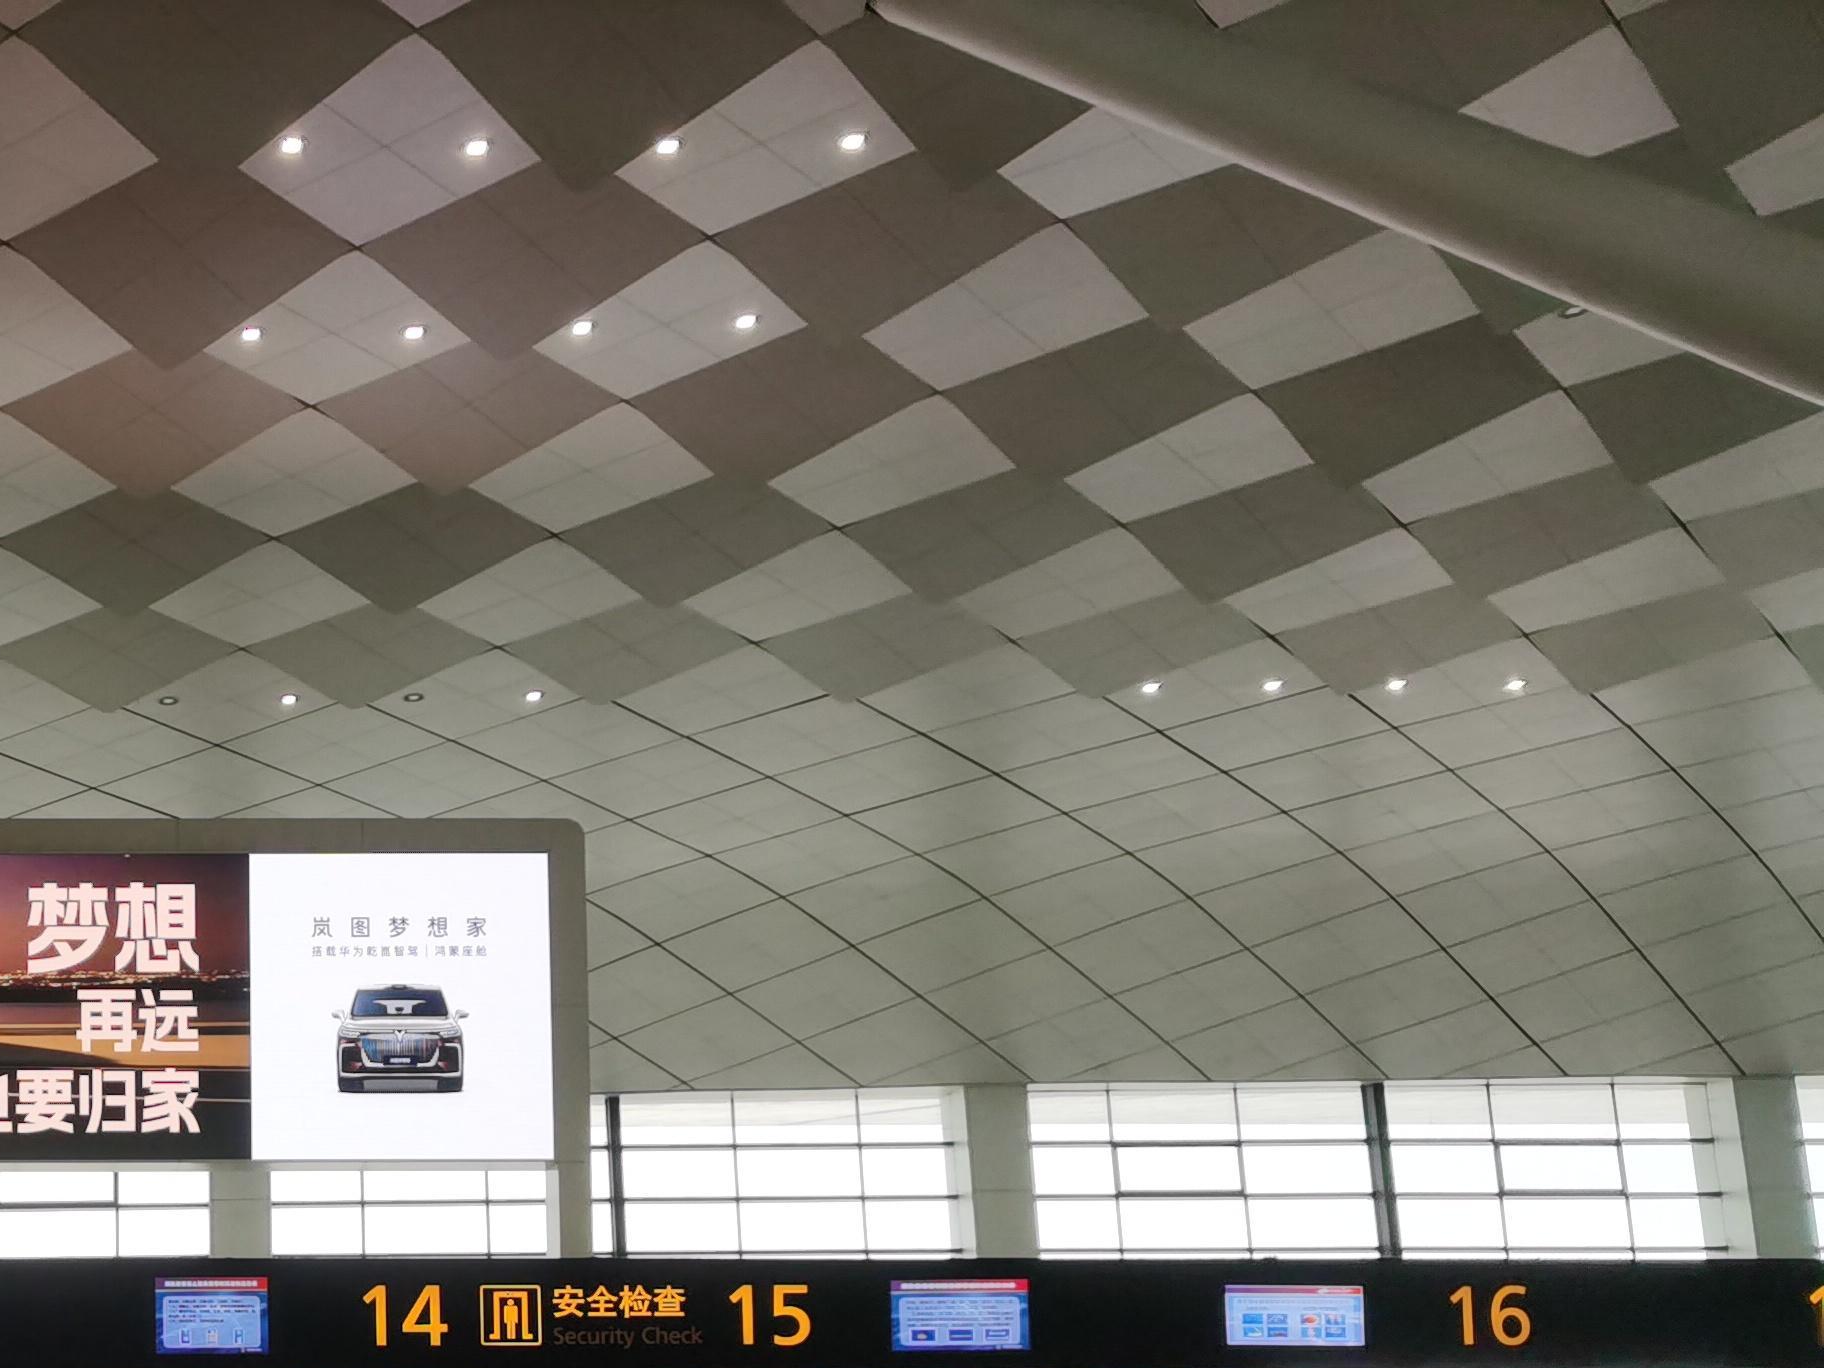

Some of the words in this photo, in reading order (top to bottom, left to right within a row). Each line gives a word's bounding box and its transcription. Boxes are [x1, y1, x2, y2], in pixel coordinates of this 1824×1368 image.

[27, 882, 199, 976] 梦想
[312, 917, 487, 938] 岚图梦想家
[76, 988, 199, 1053] 再远
[362, 1284, 448, 1347] 14
[552, 1285, 686, 1319] 安全检查
[729, 1284, 812, 1346] 15
[1448, 1283, 1532, 1346] 16
[553, 1327, 635, 1349] Security
[642, 1326, 704, 1345] Check
